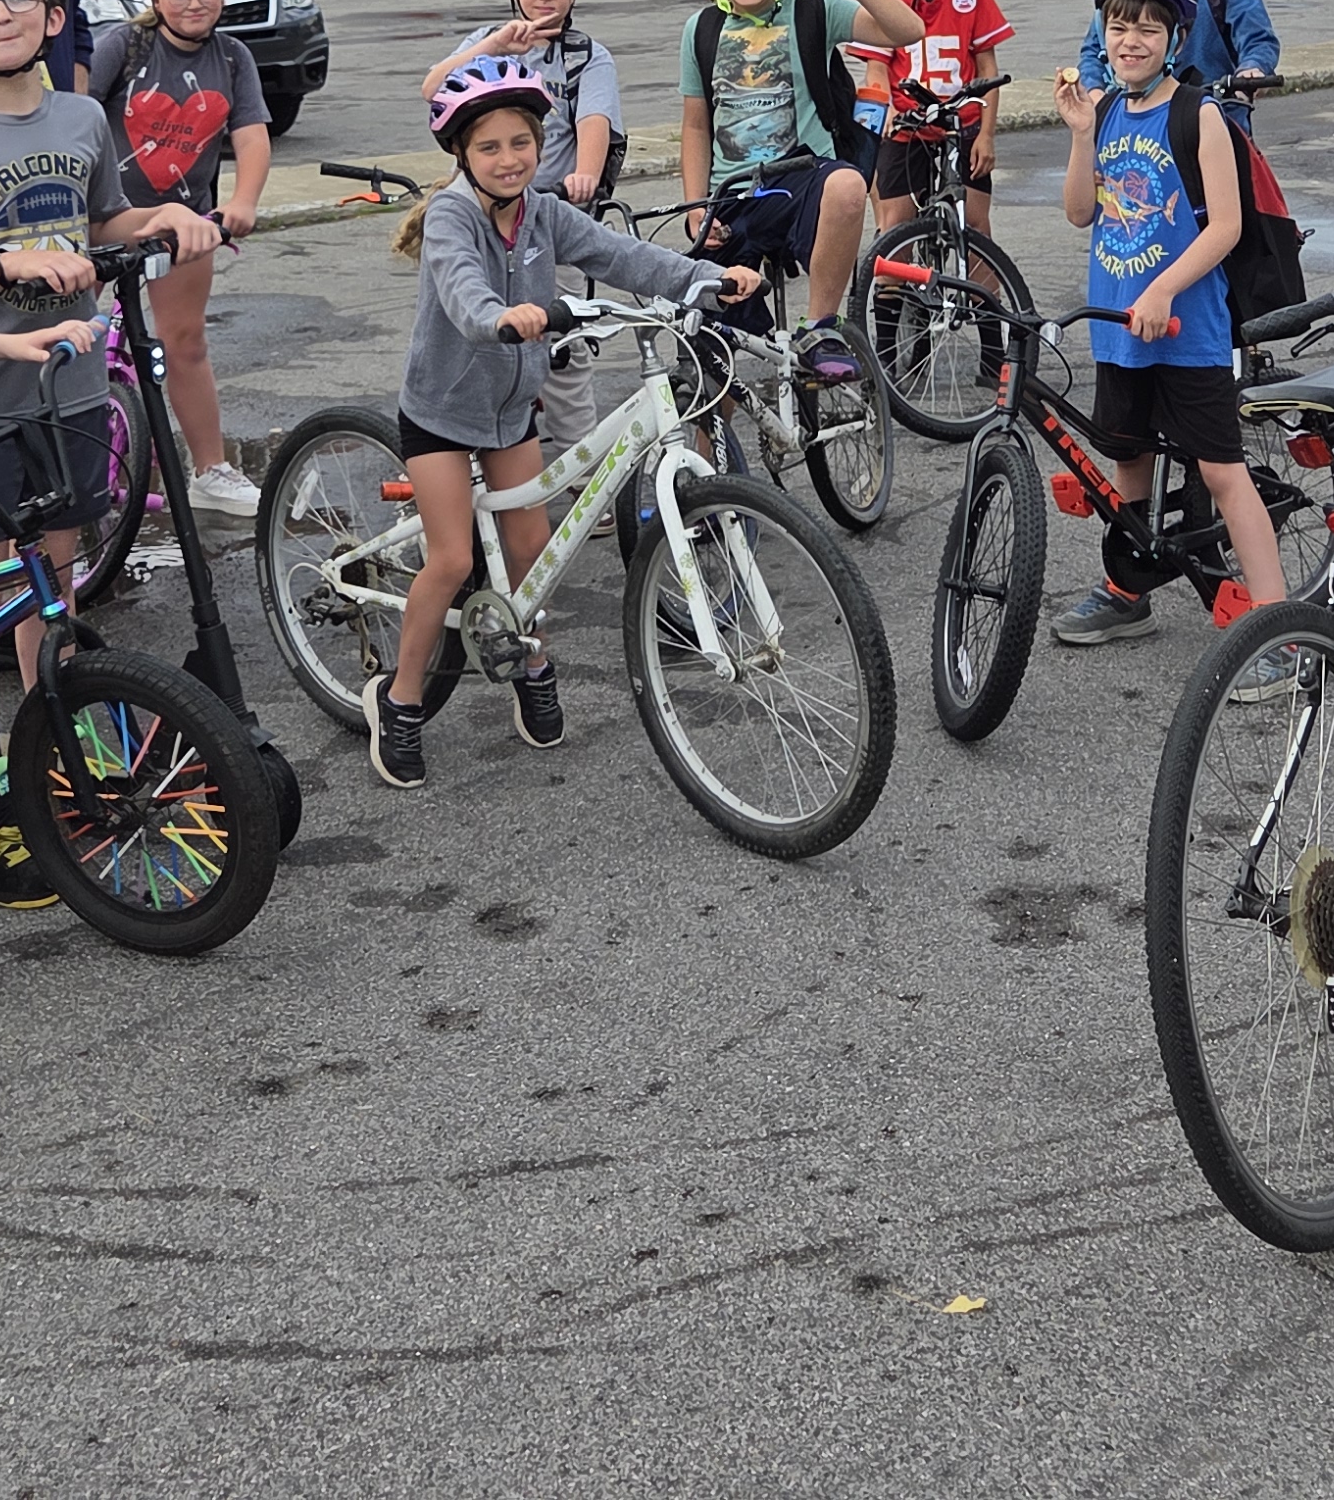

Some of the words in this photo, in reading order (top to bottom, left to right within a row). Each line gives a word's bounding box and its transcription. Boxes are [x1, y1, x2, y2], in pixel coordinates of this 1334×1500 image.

[904, 35, 963, 96] 15
[151, 118, 193, 135] olivia
[1133, 133, 1176, 173] WHITE
[1126, 243, 1170, 278] TOUR
[556, 434, 629, 542] TREK
